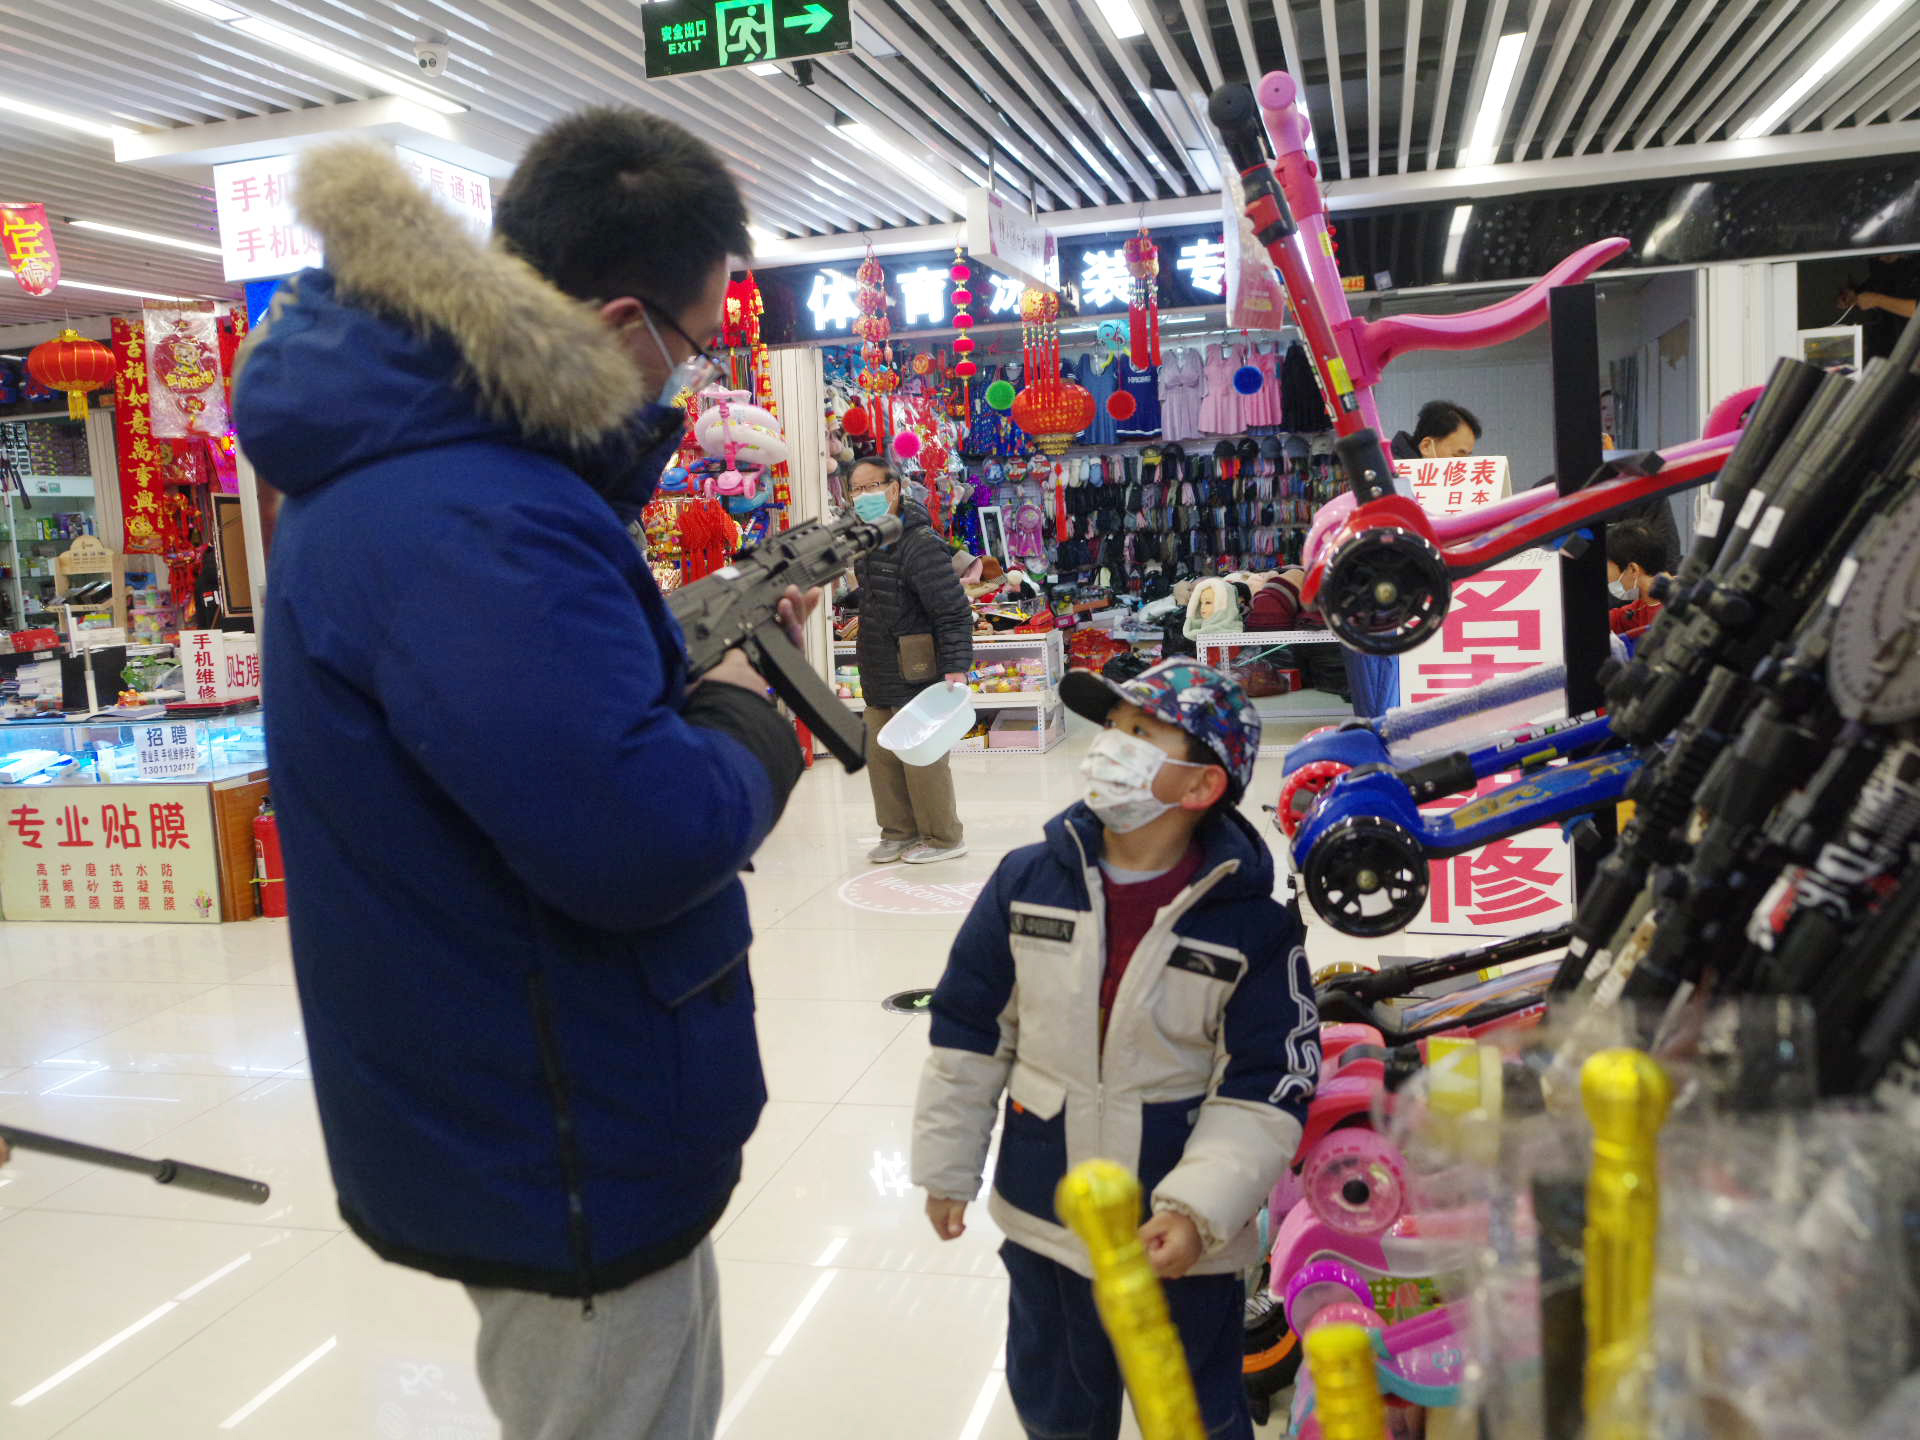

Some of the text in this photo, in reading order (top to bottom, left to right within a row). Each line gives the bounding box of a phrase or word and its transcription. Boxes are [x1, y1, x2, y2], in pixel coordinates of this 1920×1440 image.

[661, 19, 707, 42] 安全出口
[668, 40, 702, 55] EXIT
[192, 633, 216, 699] 手机维修
[226, 653, 262, 689] 贴膜
[146, 724, 188, 748] 招聘
[7, 802, 191, 850] 专业贴膜
